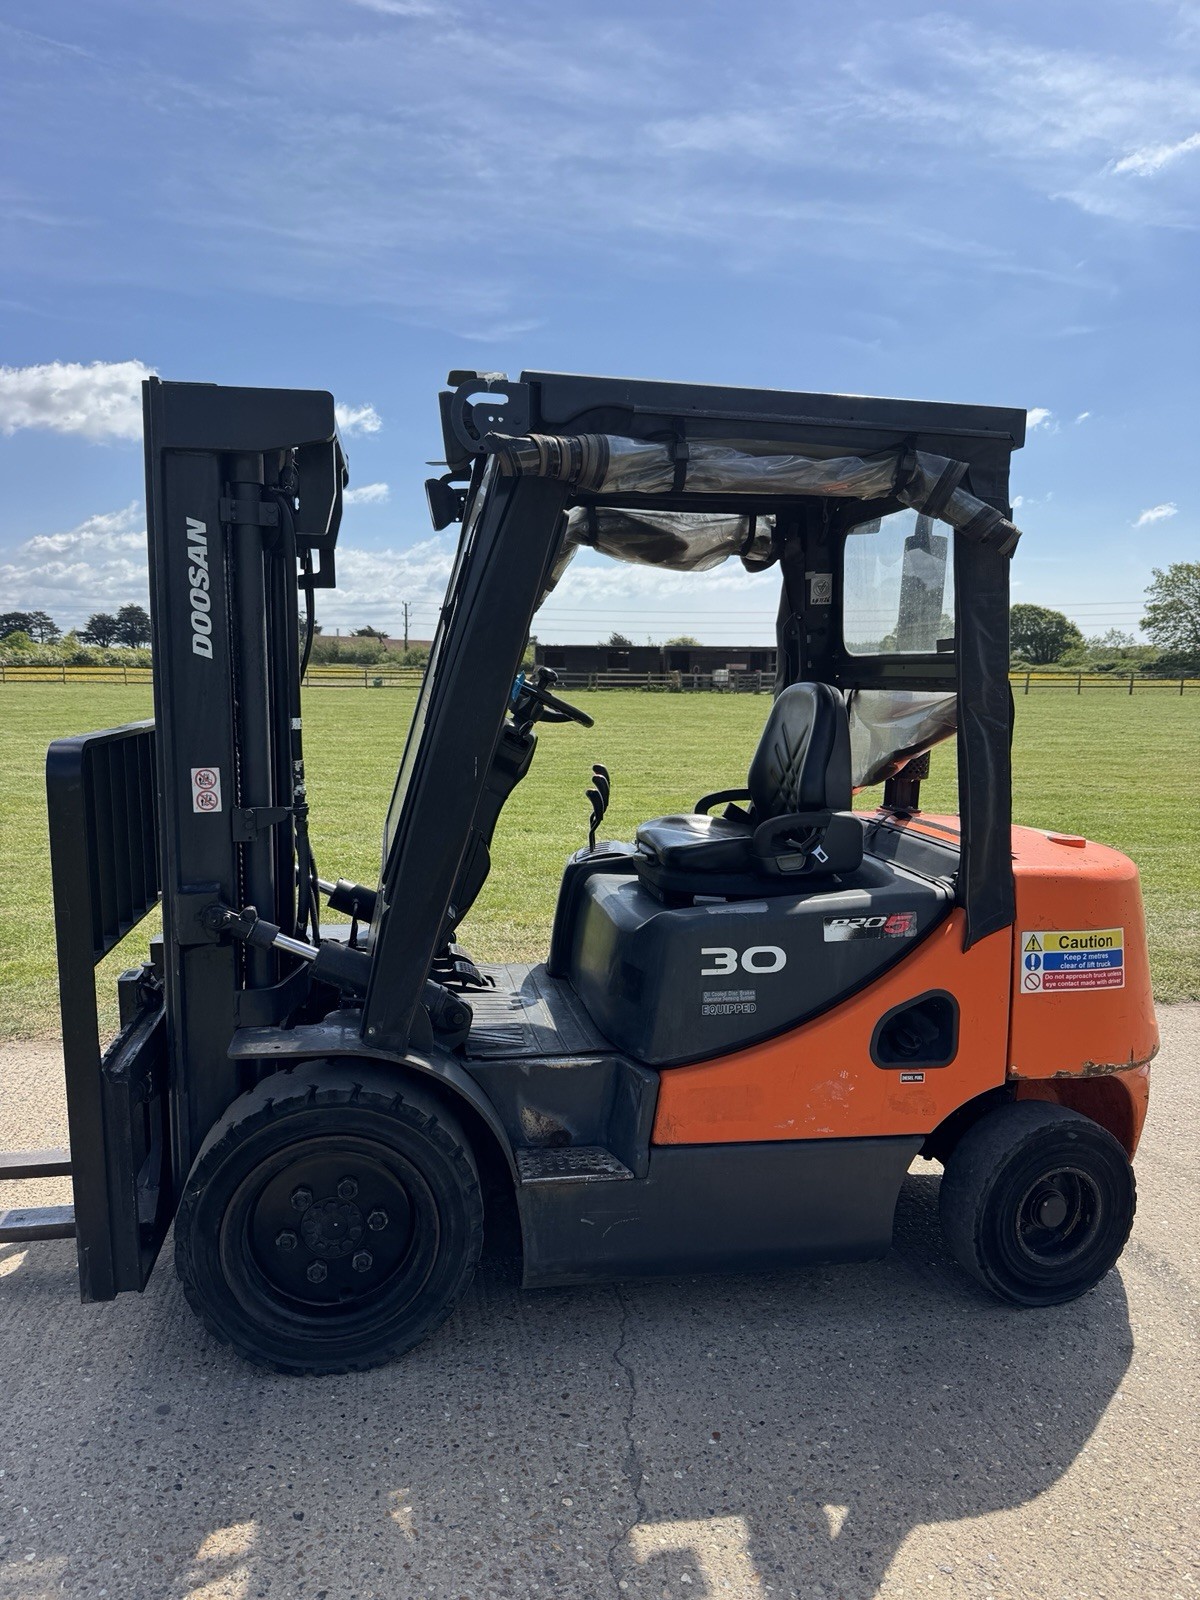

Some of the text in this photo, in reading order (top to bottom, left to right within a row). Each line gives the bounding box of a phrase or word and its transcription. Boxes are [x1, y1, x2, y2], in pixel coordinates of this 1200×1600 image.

[186, 517, 213, 659] DOOSAN
[1059, 935, 1113, 949] Caution
[701, 945, 787, 976] 30
[1063, 953, 1081, 962] Keep
[1065, 972, 1092, 980] approach
[702, 1003, 756, 1015] EQUIPPED
